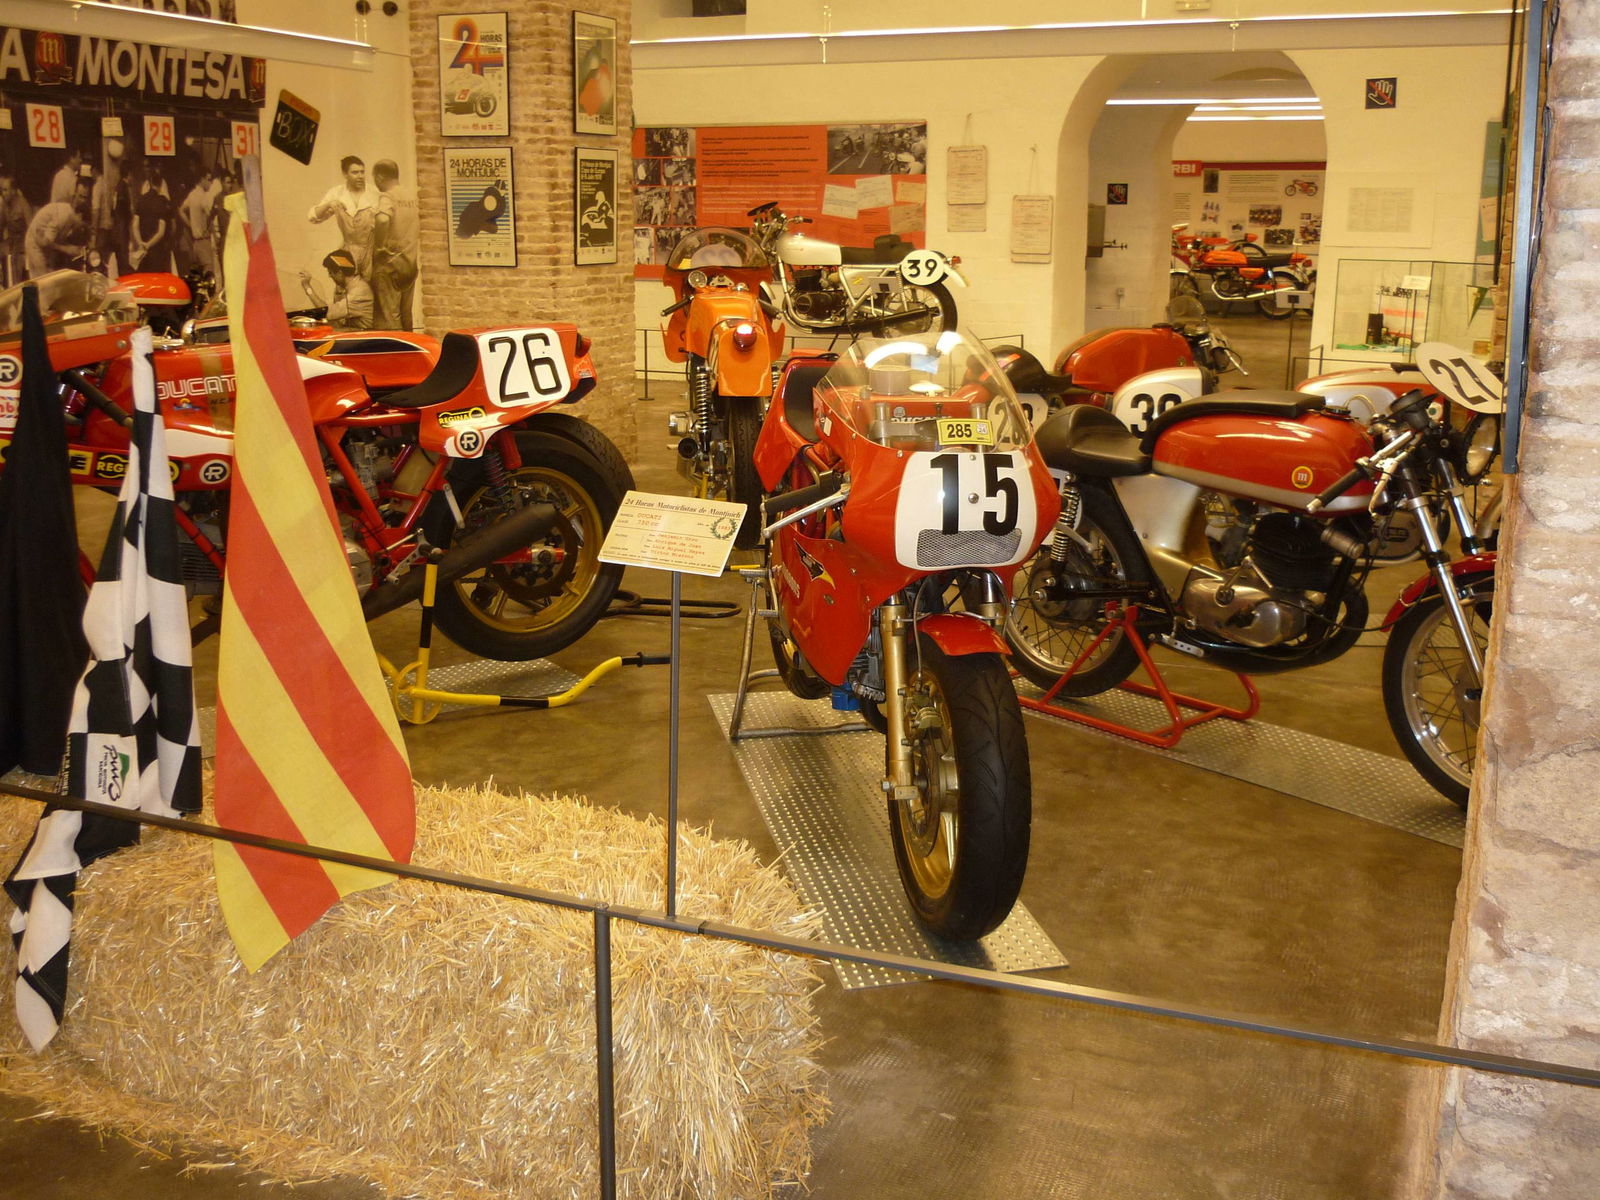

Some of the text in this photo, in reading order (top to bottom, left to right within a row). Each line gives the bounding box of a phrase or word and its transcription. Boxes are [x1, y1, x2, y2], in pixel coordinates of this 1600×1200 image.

[75, 37, 247, 100] MONTESA
[32, 108, 61, 143] 28
[150, 121, 172, 152] 29
[236, 125, 255, 156] 31
[450, 158, 507, 168] 24 HORAS DE
[907, 259, 938, 278] 39
[488, 333, 562, 403] 26
[1429, 358, 1500, 406] 27
[157, 374, 237, 400] DUCAT
[438, 412, 470, 426] REGINA
[947, 423, 972, 438] 285
[97, 460, 128, 472] REG
[625, 498, 634, 506] 24
[635, 499, 654, 508] Horas
[698, 506, 707, 514] de
[930, 454, 1018, 536] 15
